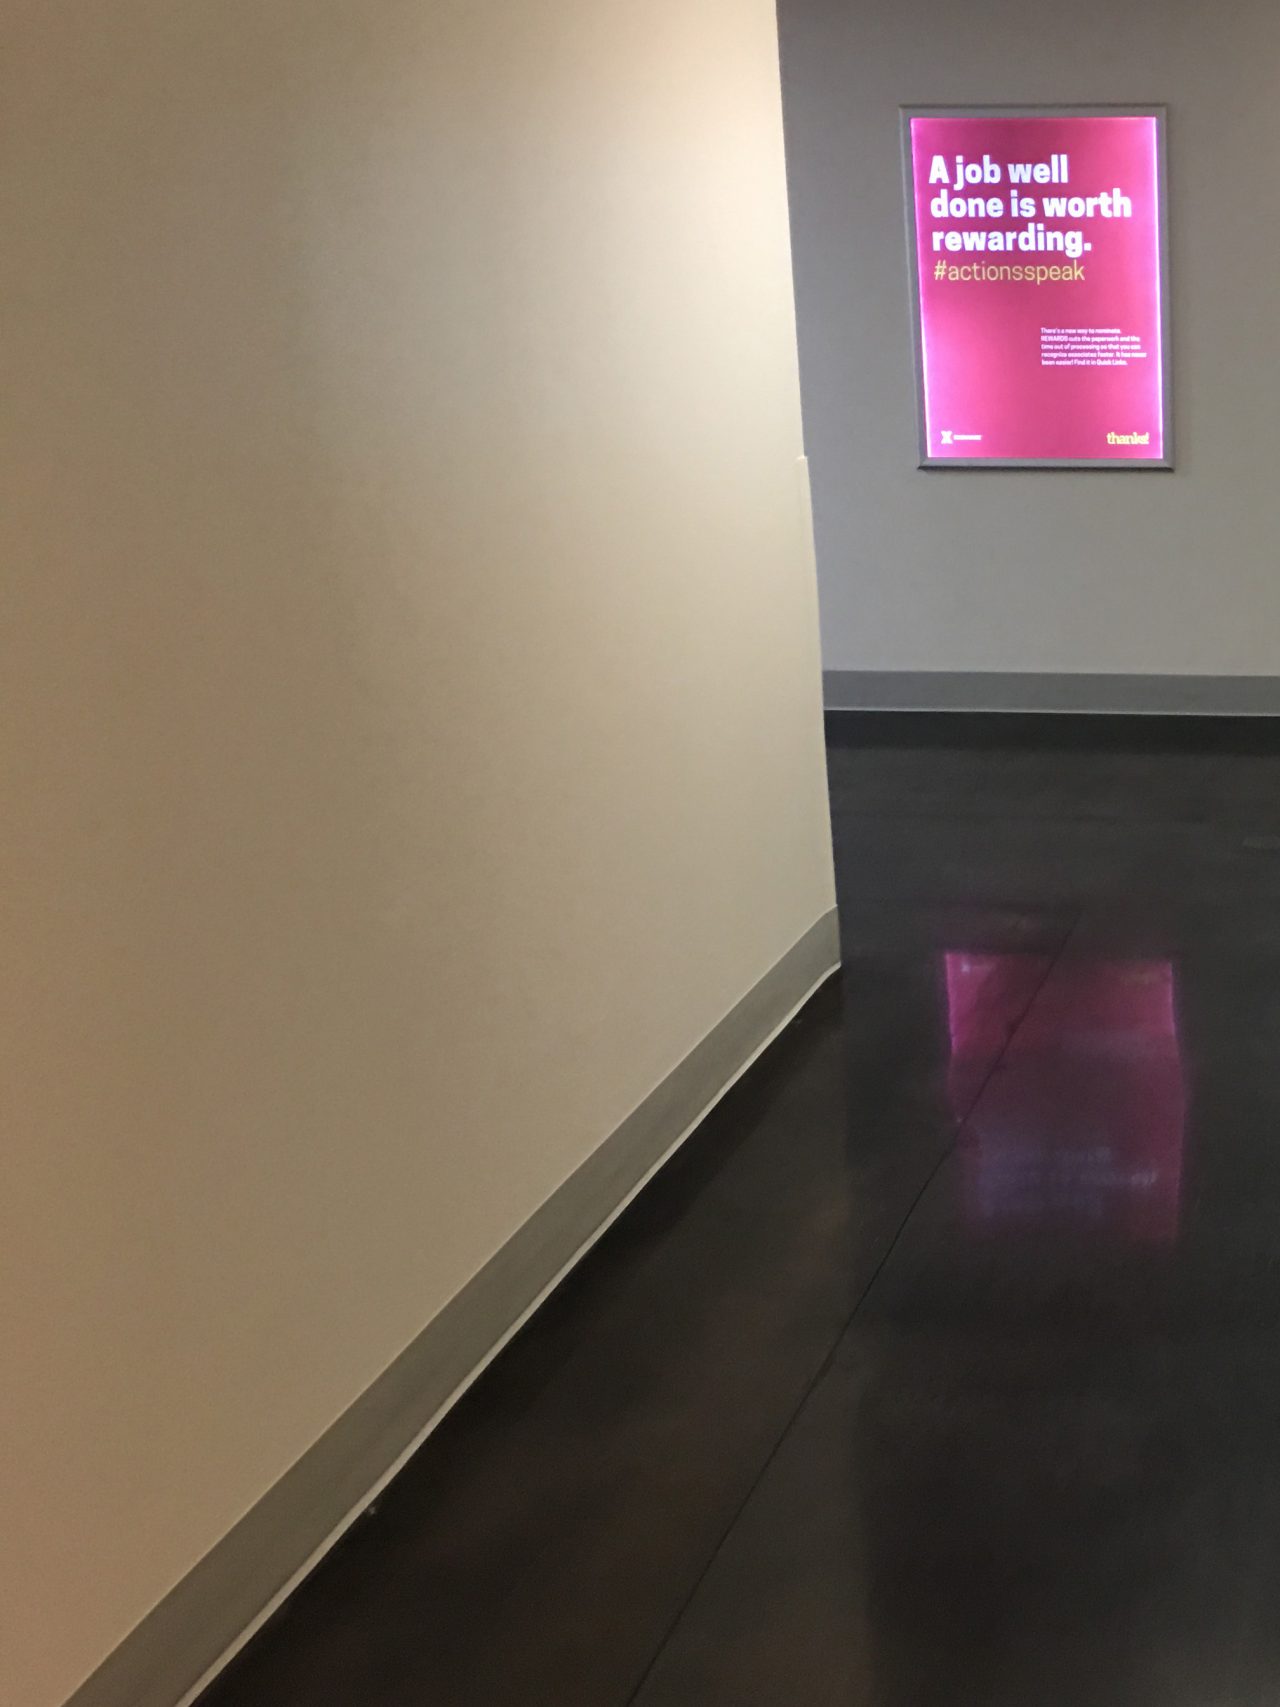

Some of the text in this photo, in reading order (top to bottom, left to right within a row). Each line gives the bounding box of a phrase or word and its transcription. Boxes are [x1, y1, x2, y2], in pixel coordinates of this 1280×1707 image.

[928, 153, 1069, 191] A job well
[930, 187, 1132, 219] done is worth
[931, 222, 1092, 259] rewarding.
[933, 259, 1085, 285] #actionsspeak
